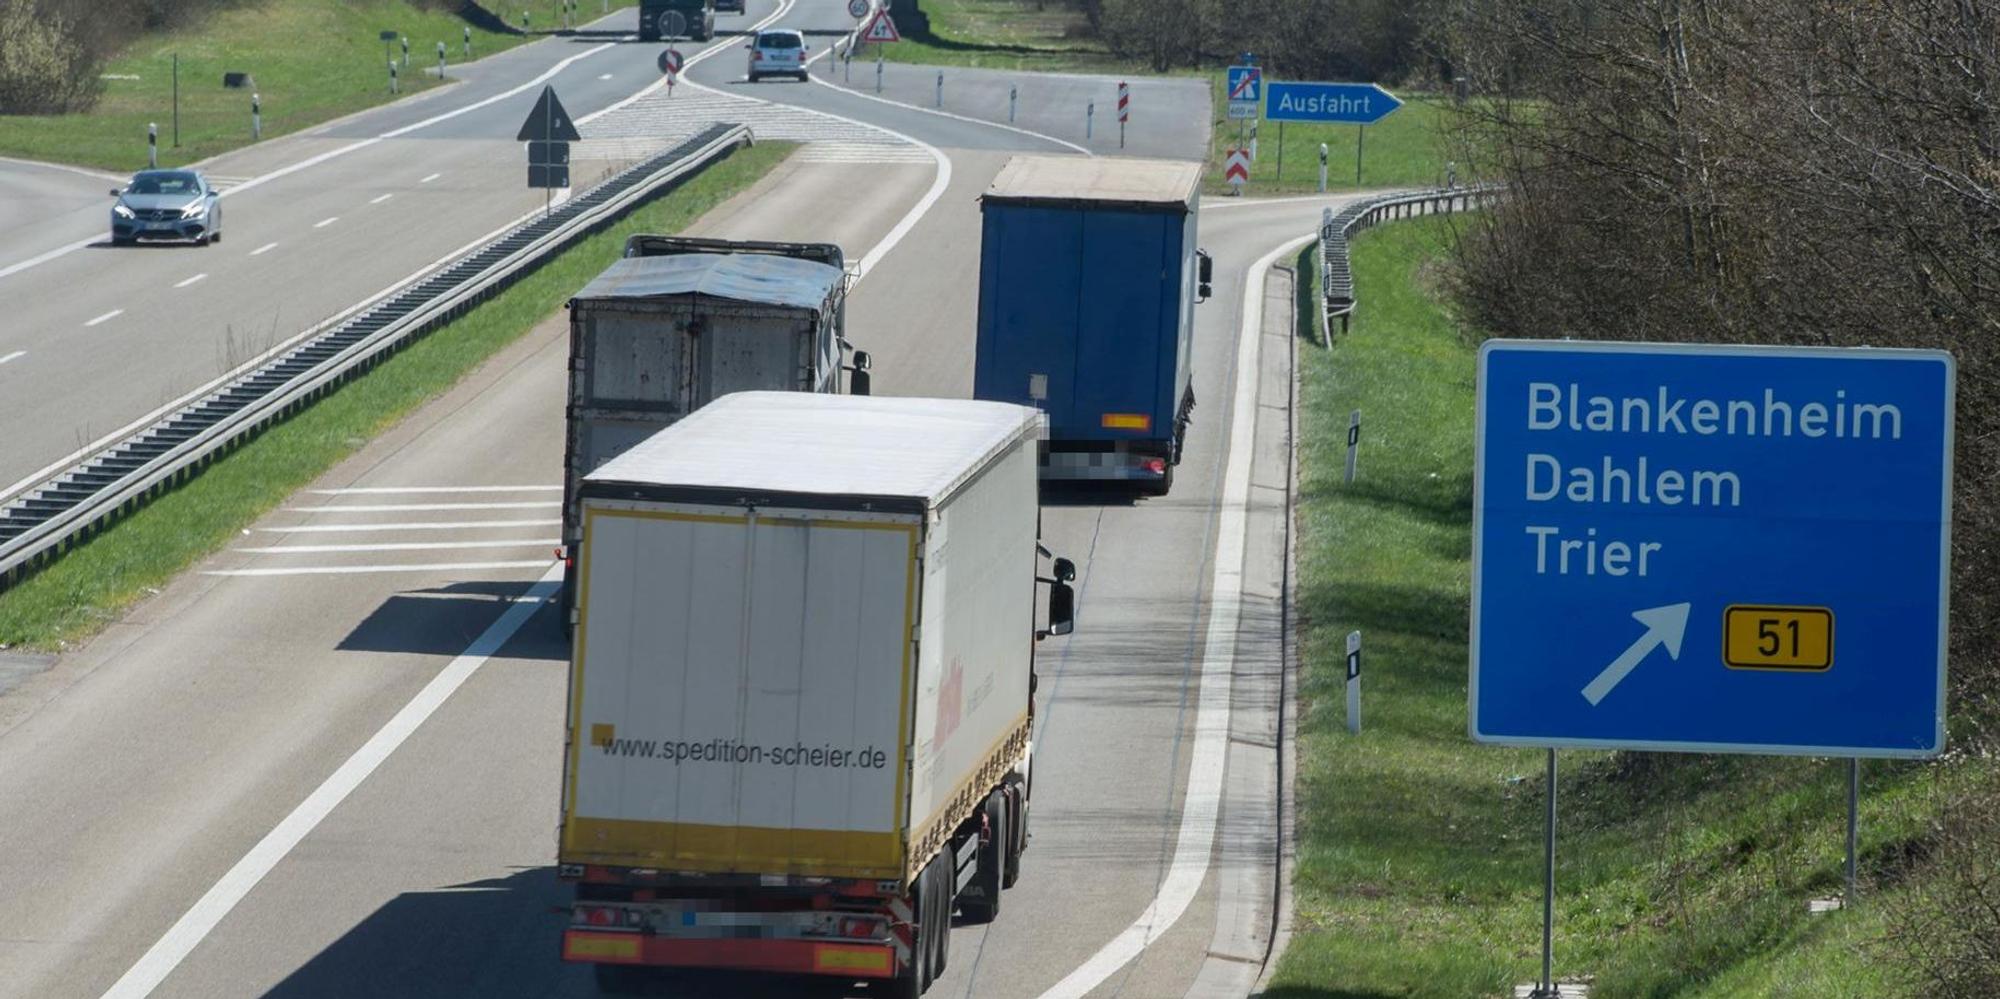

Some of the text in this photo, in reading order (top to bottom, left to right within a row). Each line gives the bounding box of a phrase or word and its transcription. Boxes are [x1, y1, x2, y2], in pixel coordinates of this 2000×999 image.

[1278, 92, 1371, 115] Ausfahrt
[1527, 382, 1902, 439] Blankenheim
[1525, 453, 1741, 506] Dahlem
[1525, 525, 1662, 576] Trier
[1758, 618, 1799, 658] 51
[601, 736, 887, 769] www.spedition-scheier.de
